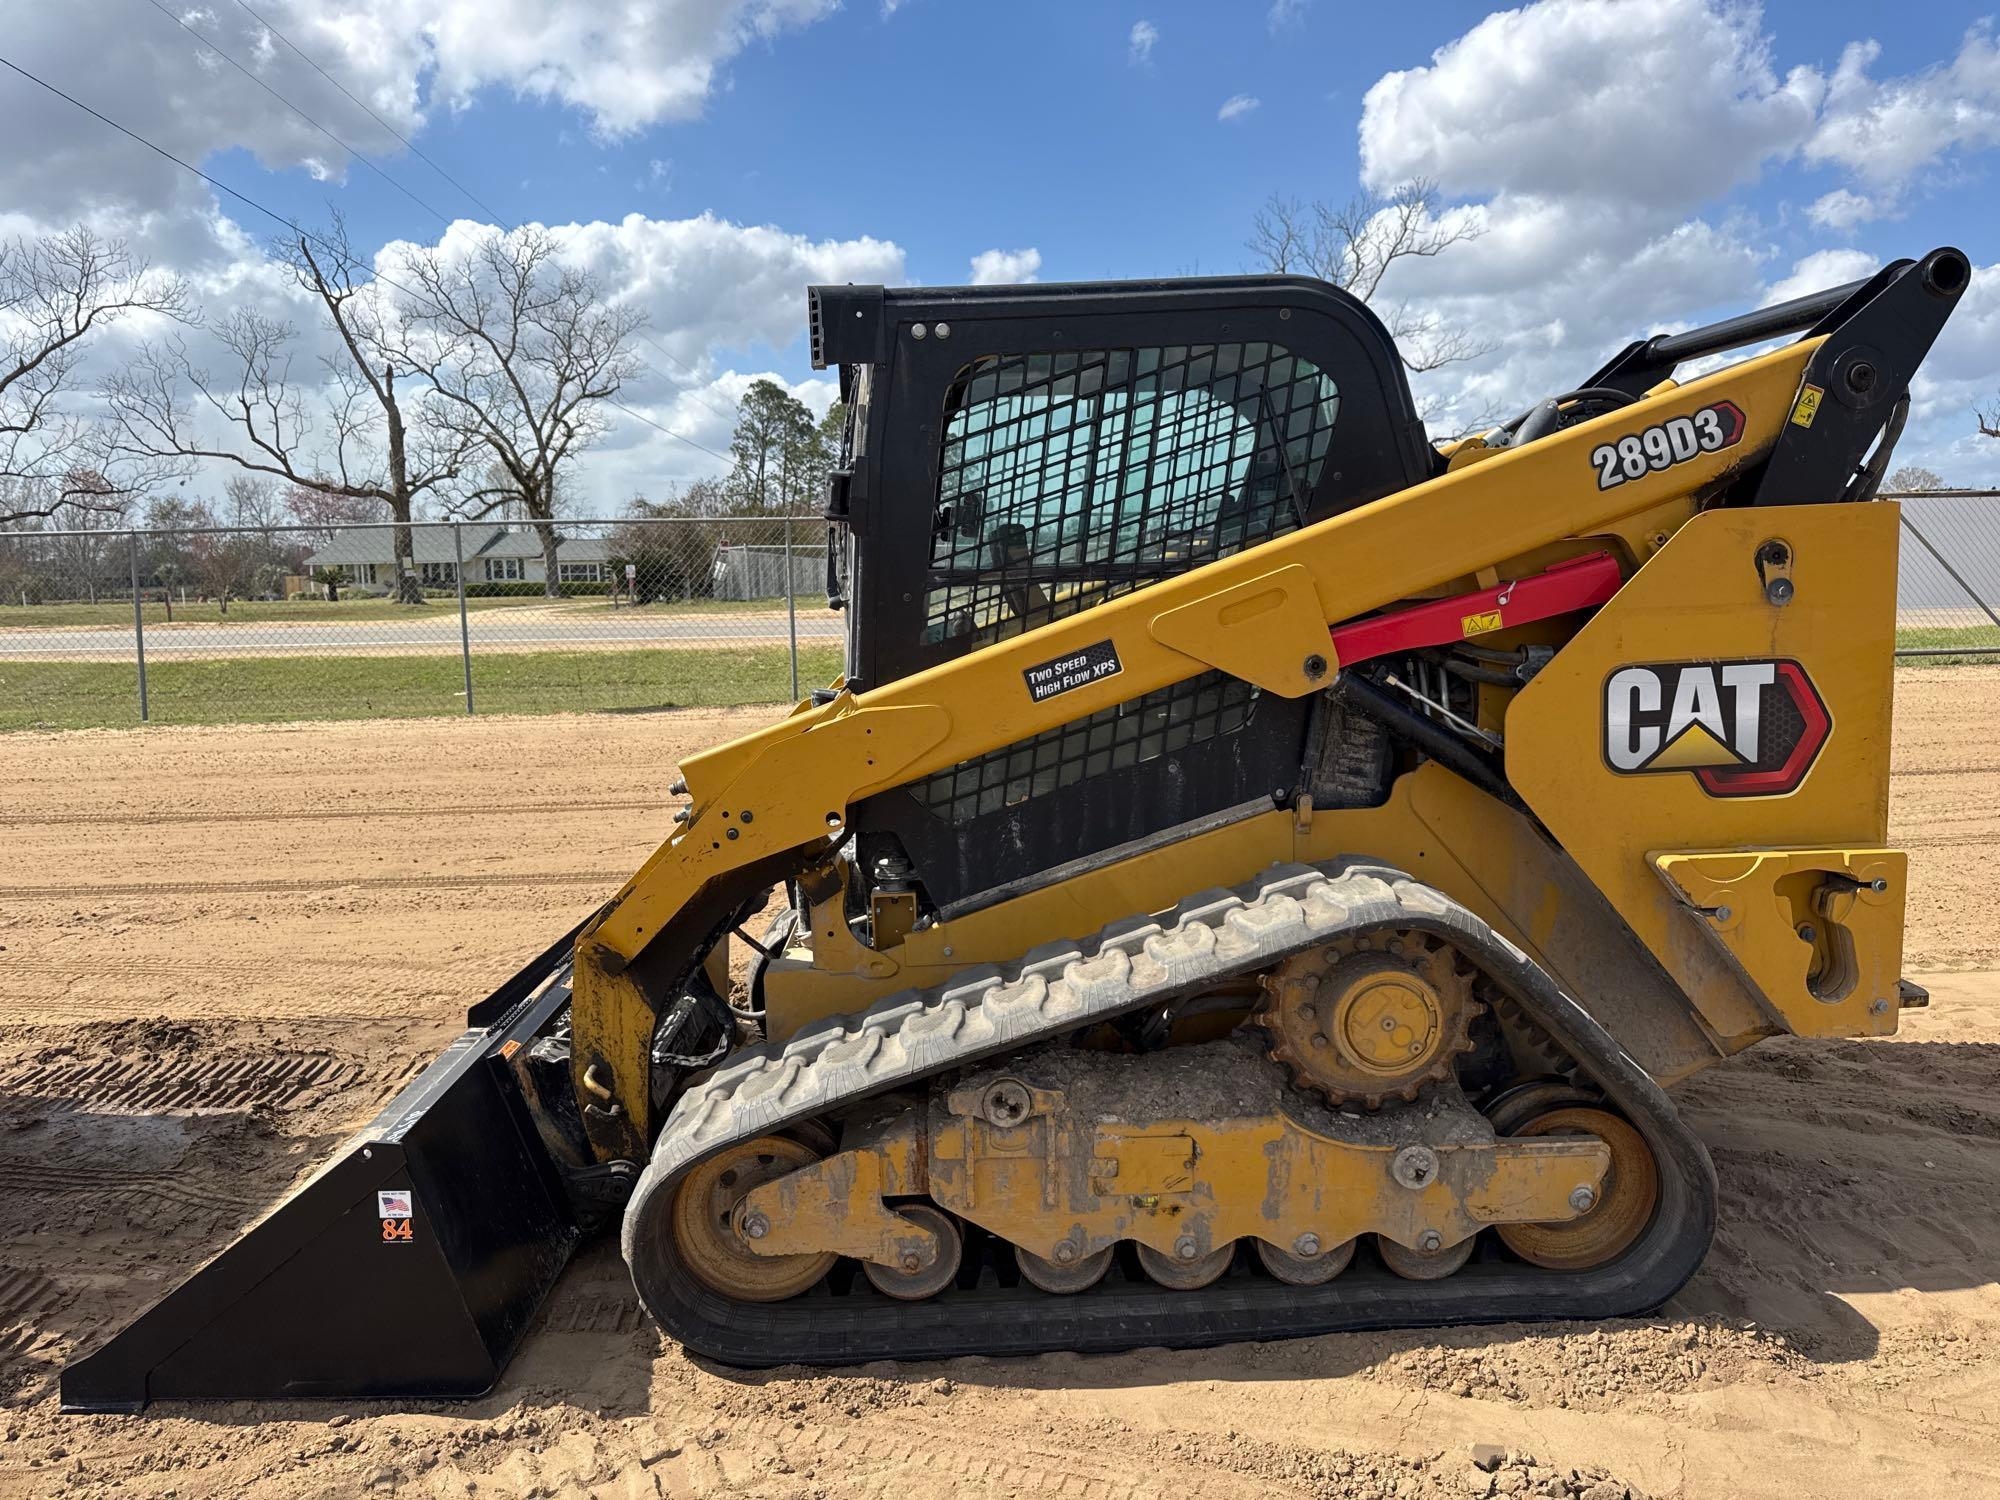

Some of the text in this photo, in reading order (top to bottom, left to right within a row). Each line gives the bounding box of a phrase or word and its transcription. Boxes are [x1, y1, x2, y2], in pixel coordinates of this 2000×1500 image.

[1592, 408, 1724, 489] 289D3
[1028, 655, 1087, 684] TWO SPEED
[1035, 659, 1116, 699] HIGH FLOW XPS
[1607, 663, 1775, 770] CAT
[382, 1218, 413, 1240] 84
